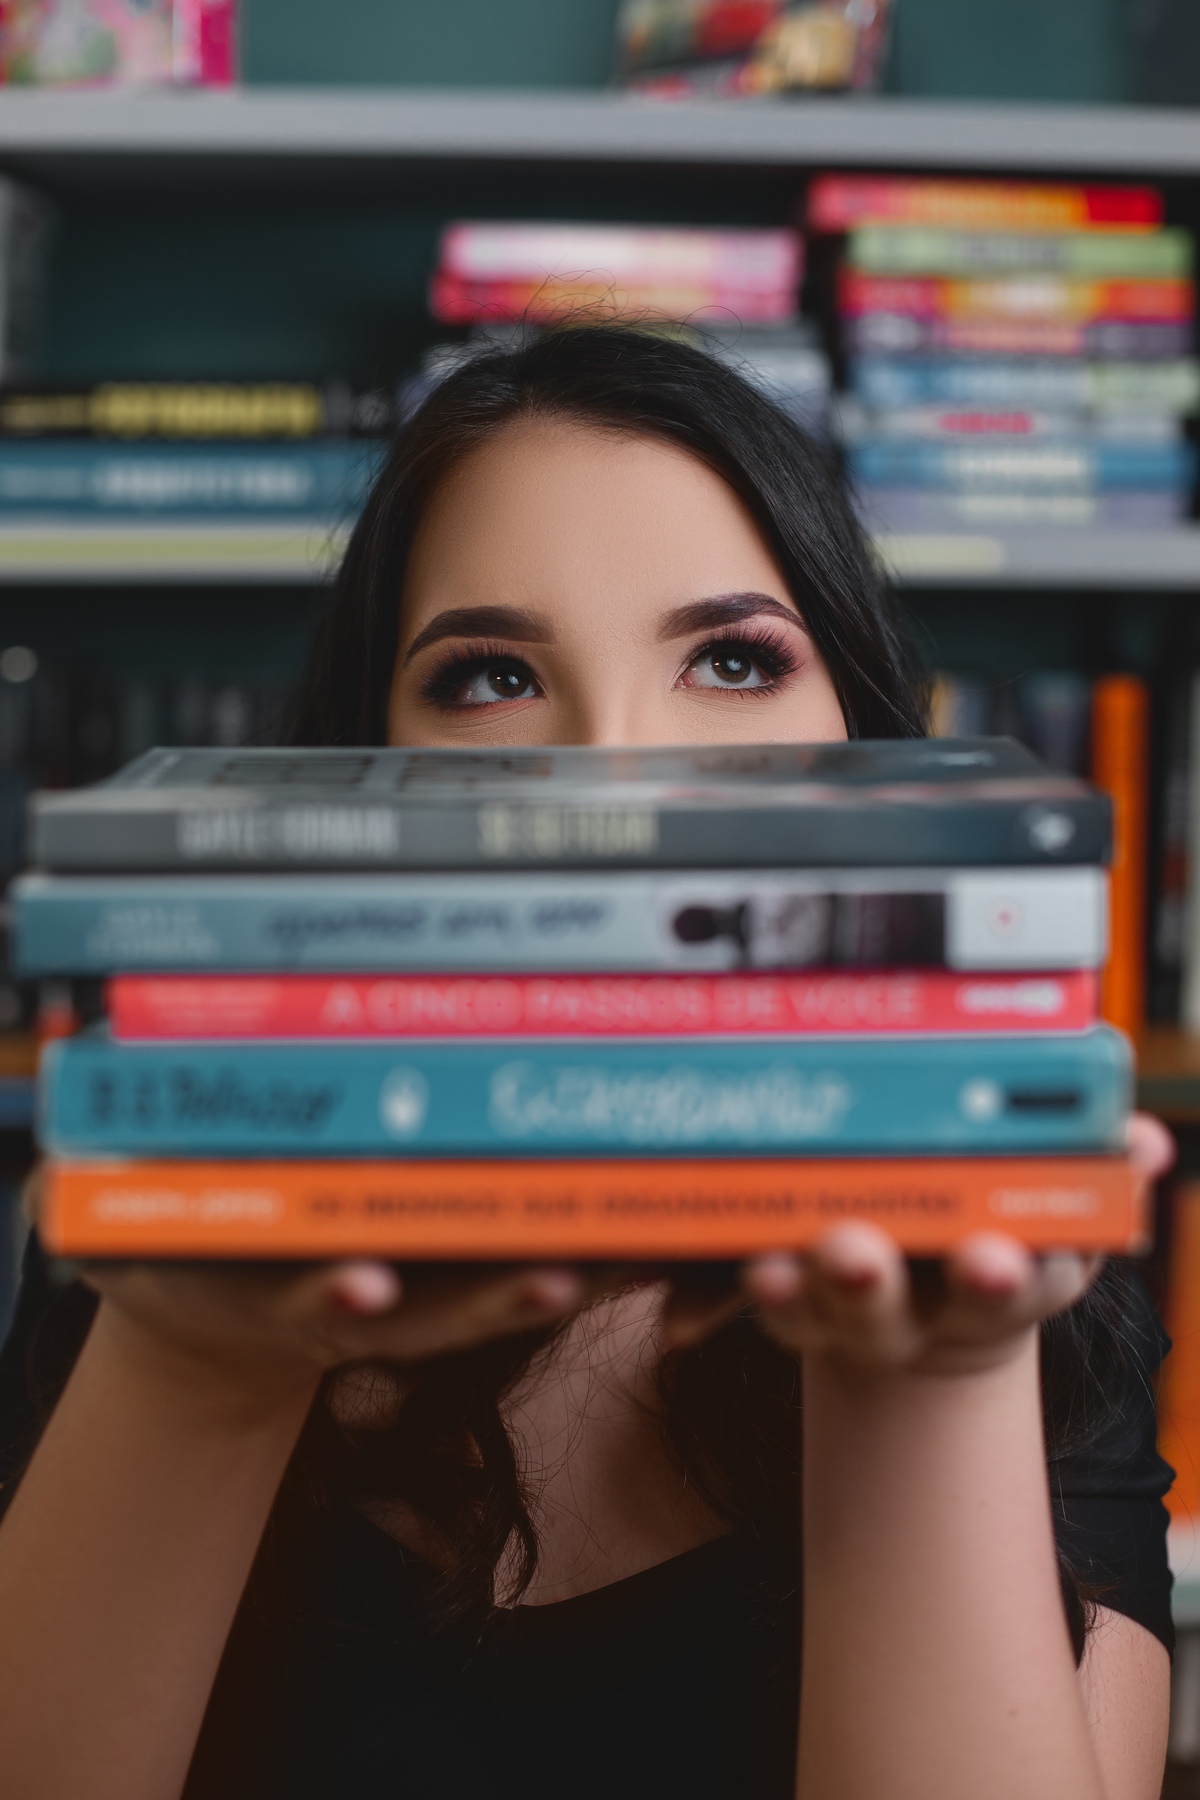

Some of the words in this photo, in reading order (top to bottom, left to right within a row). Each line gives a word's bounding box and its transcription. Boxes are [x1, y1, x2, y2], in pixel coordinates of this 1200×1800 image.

[324, 981, 361, 1028] A
[368, 980, 520, 1028] CINCO
[527, 979, 711, 1027] PASSOS
[716, 978, 788, 1025] DE
